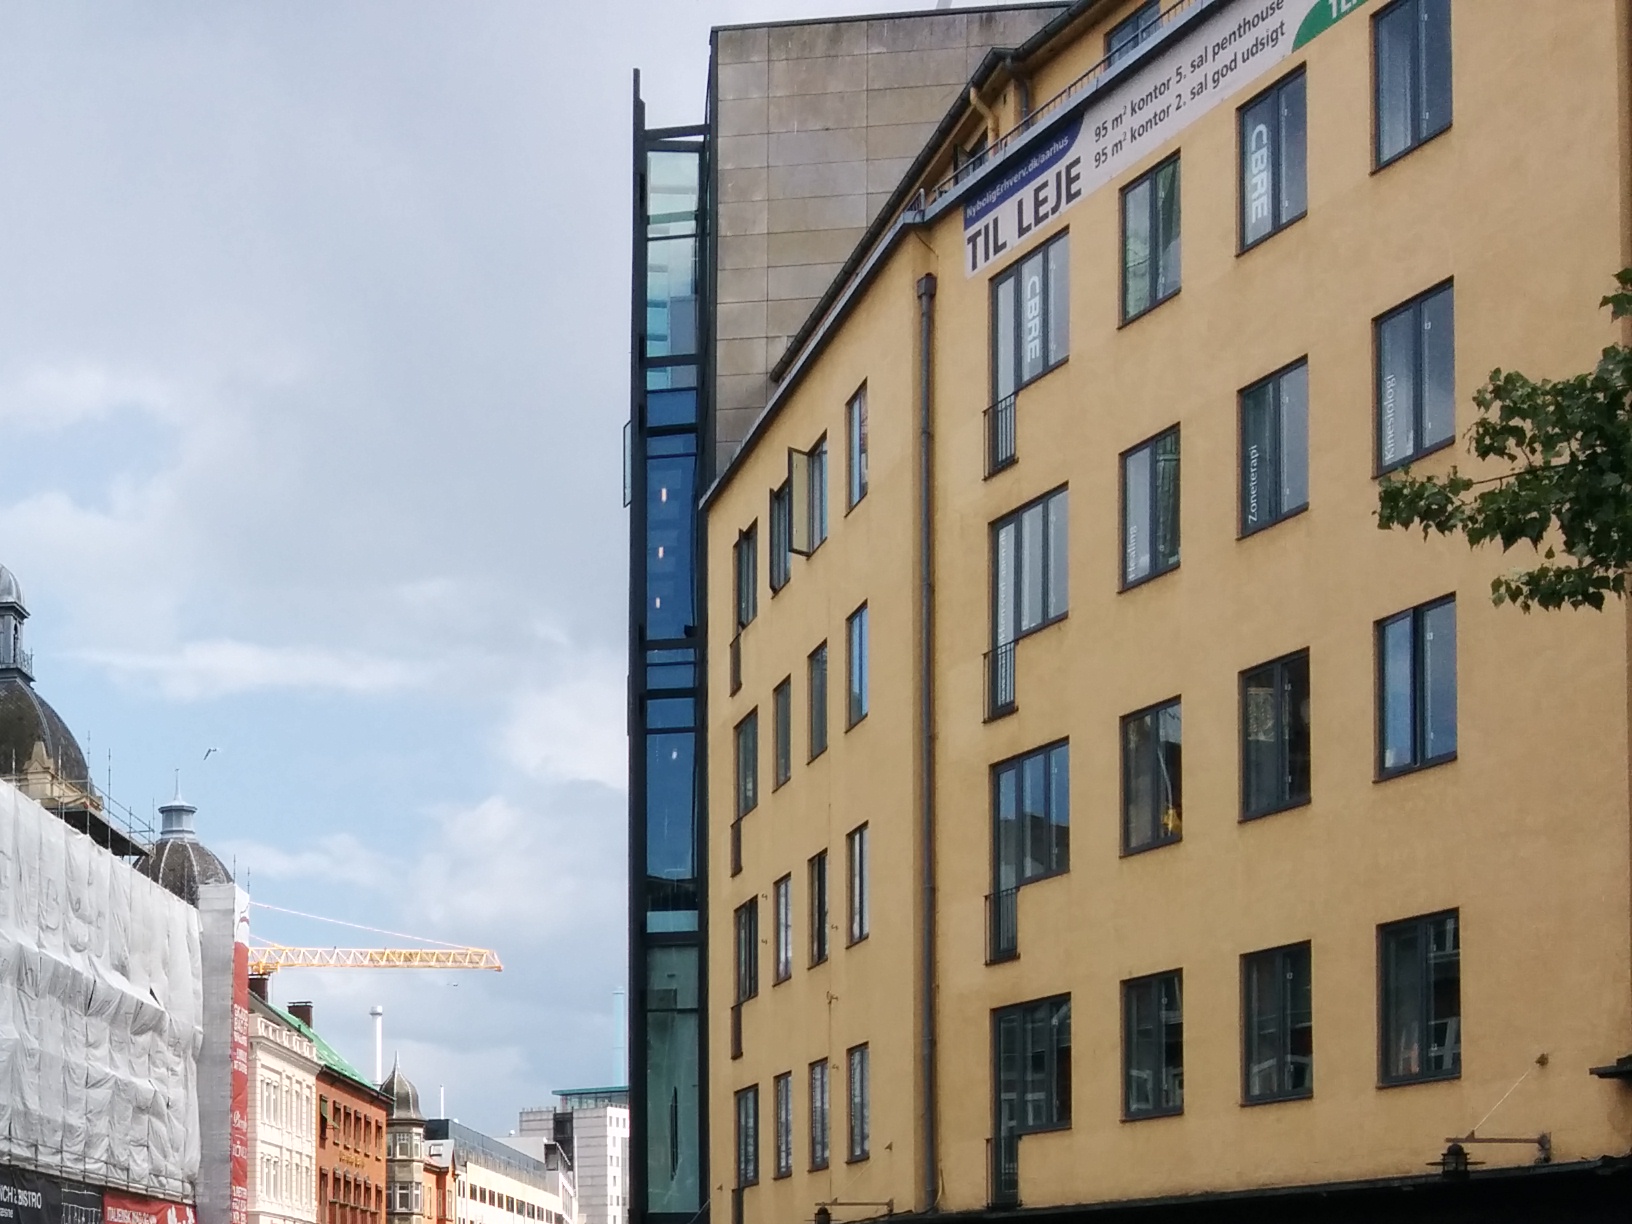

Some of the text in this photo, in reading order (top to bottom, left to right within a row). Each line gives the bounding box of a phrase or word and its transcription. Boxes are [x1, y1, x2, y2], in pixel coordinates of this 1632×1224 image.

[1094, 119, 1108, 143] 95
[1130, 76, 1172, 117] kontor
[1175, 66, 1187, 84] 5.
[1190, 49, 1208, 74] sal
[1212, 0, 1284, 62] penthouse
[1094, 146, 1108, 169] 95
[1130, 104, 1172, 144] kontor
[1175, 94, 1187, 112] 2.
[1190, 77, 1208, 101] sal
[1212, 56, 1238, 89] god
[1242, 20, 1286, 63] udsigt
[967, 155, 1082, 272] TIL LEJE
[1251, 122, 1268, 223] CBRE
[1027, 275, 1040, 363] CBRE
[1248, 444, 1260, 525] Zoneterapi
[18, 1189, 42, 1210] BISTRO
